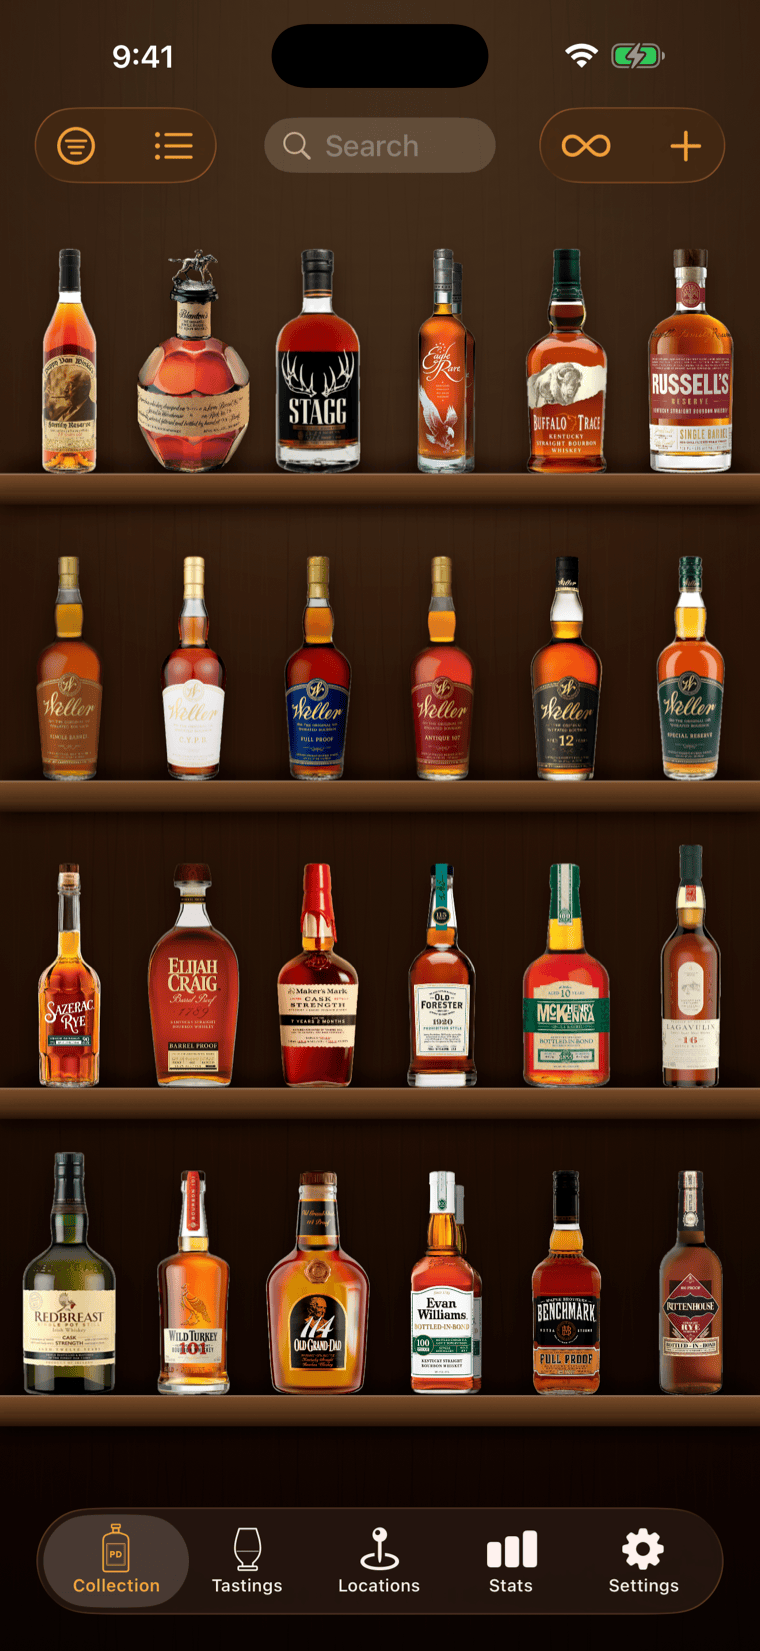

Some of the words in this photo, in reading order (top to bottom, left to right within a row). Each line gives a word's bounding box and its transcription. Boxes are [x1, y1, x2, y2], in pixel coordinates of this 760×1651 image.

[112, 44, 174, 70] 9:41
[325, 134, 420, 158] Search
[179, 309, 208, 320] Blanton's
[59, 357, 73, 365] Van
[426, 360, 463, 382] Rare
[652, 373, 729, 395] RUSSELL'S
[289, 398, 346, 424] STAGG
[533, 414, 567, 431] BUFFALO
[578, 414, 600, 431] TRACE
[680, 428, 706, 440] SINGLE
[707, 428, 728, 439] BARREL
[558, 578, 577, 586] Weller
[43, 691, 96, 717] Weller
[168, 697, 218, 721] Weller
[292, 696, 343, 720] Weller
[417, 694, 468, 719] Weller
[541, 696, 594, 720] Weller
[663, 690, 716, 716] Weller
[559, 734, 574, 747] 12
[168, 957, 218, 977] ELIJAH
[168, 973, 218, 994] CRAIG
[170, 993, 196, 1004] Barrel
[195, 993, 218, 1007] Proof
[421, 1000, 463, 1009] FORESTER
[567, 1004, 594, 1012] HENRY
[44, 1000, 94, 1023] SAZERAC
[178, 1007, 209, 1018] 1789
[61, 1014, 86, 1034] RYE
[426, 1298, 457, 1308] Evan
[666, 1302, 714, 1311] RITTENHOUSE
[35, 1311, 104, 1322] REDBREAST
[417, 1309, 467, 1320] Williams
[537, 1302, 595, 1322] BENCHMARK
[300, 1315, 335, 1338] 114
[169, 1330, 189, 1341] WILD
[189, 1330, 217, 1342] TURKEY
[180, 1342, 207, 1355] 101
[294, 1339, 307, 1352] OLD
[307, 1339, 342, 1352] GRAND-DAD
[540, 1354, 561, 1364] FULL
[565, 1354, 593, 1364] PROOF
[73, 1578, 160, 1592] Collection
[212, 1578, 282, 1596] Tastings
[338, 1578, 420, 1593] Locations
[489, 1578, 533, 1593] Stats
[608, 1578, 679, 1596] Settings
